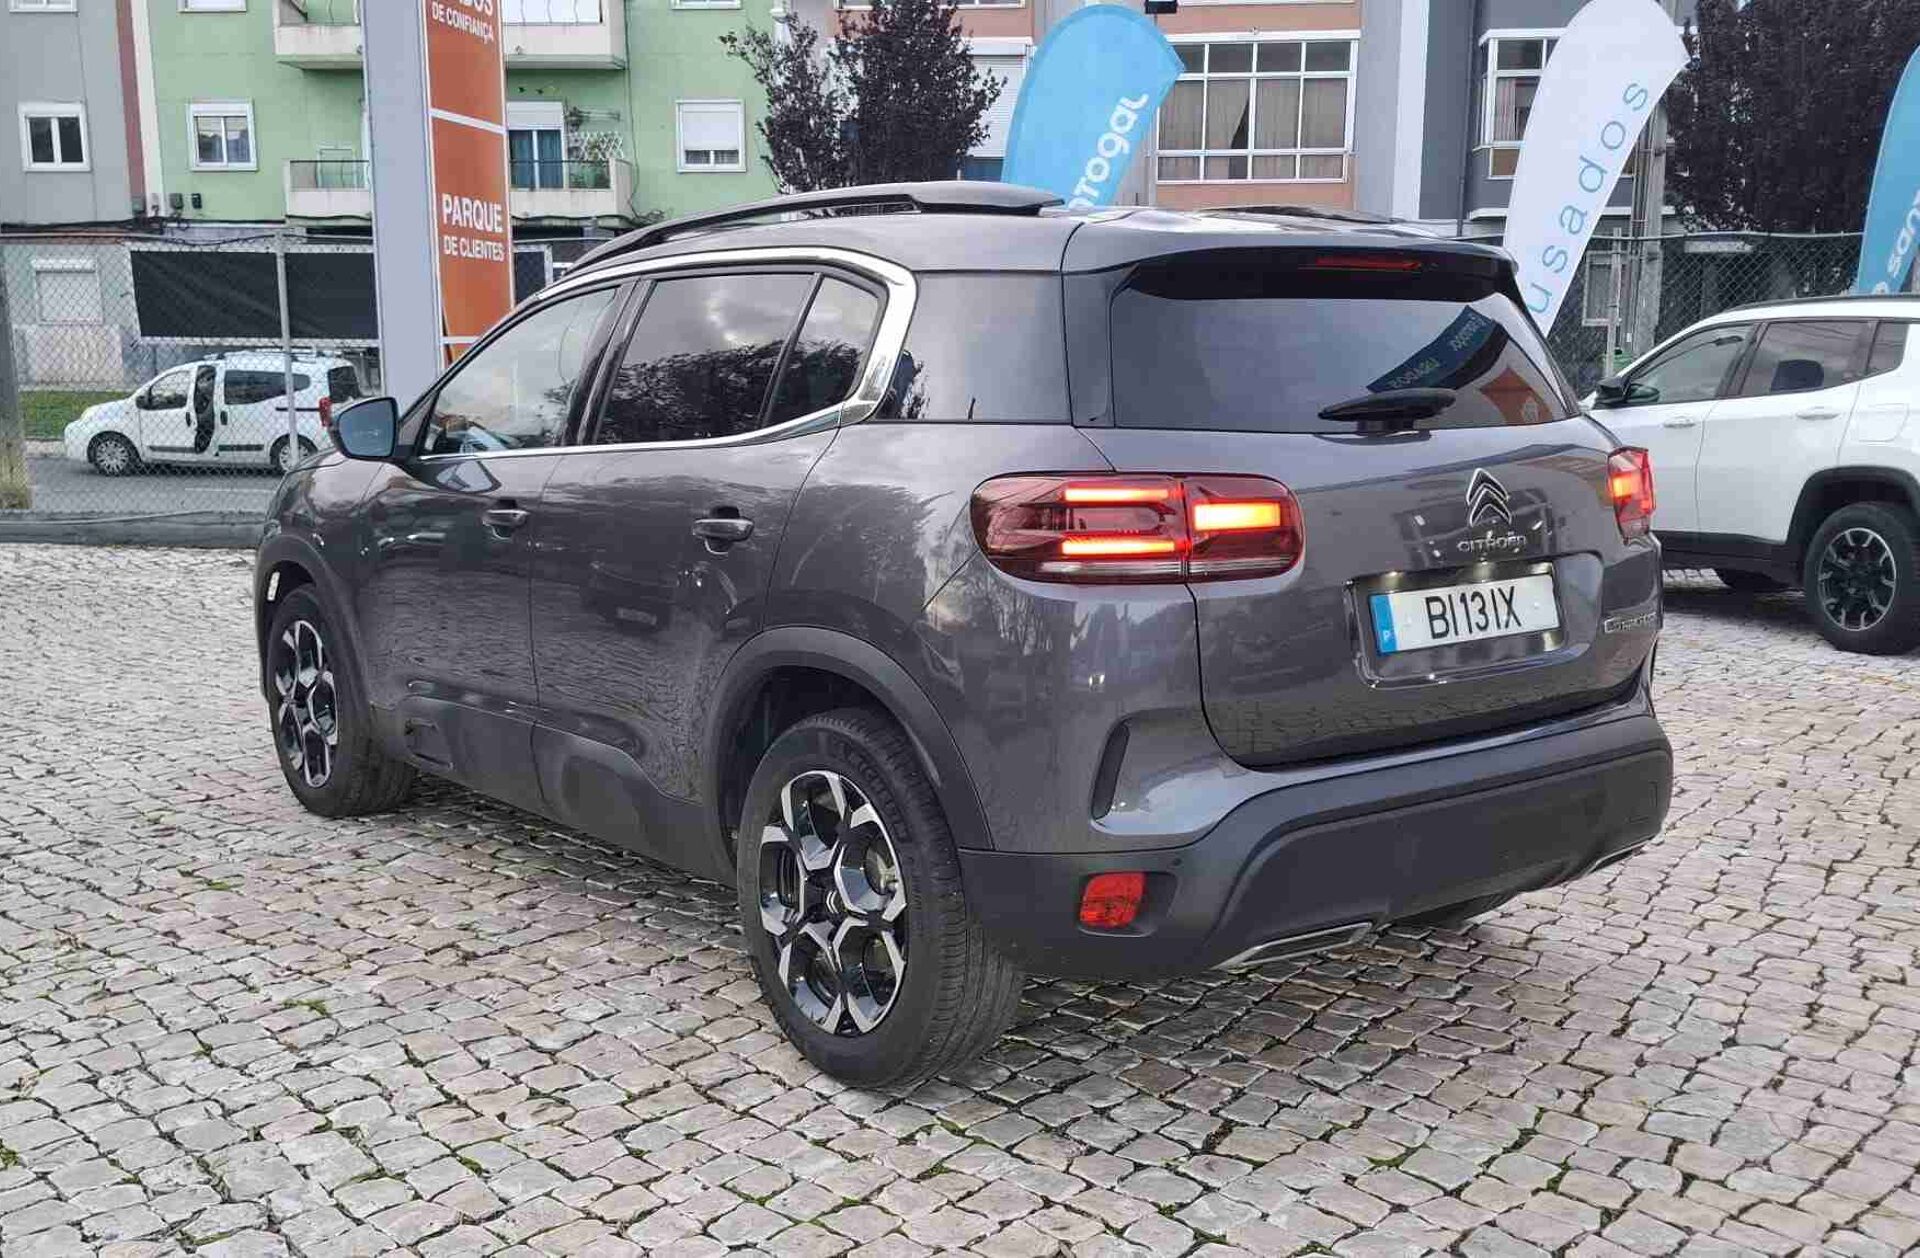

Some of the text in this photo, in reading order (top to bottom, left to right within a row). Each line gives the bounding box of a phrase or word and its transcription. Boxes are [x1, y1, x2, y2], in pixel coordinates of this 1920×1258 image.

[431, 1, 445, 23] DE
[446, 7, 494, 45] CONFIANÇA
[442, 193, 503, 233] PARQUE
[1527, 83, 1648, 313] usados
[444, 235, 504, 261] DE CLIENTES
